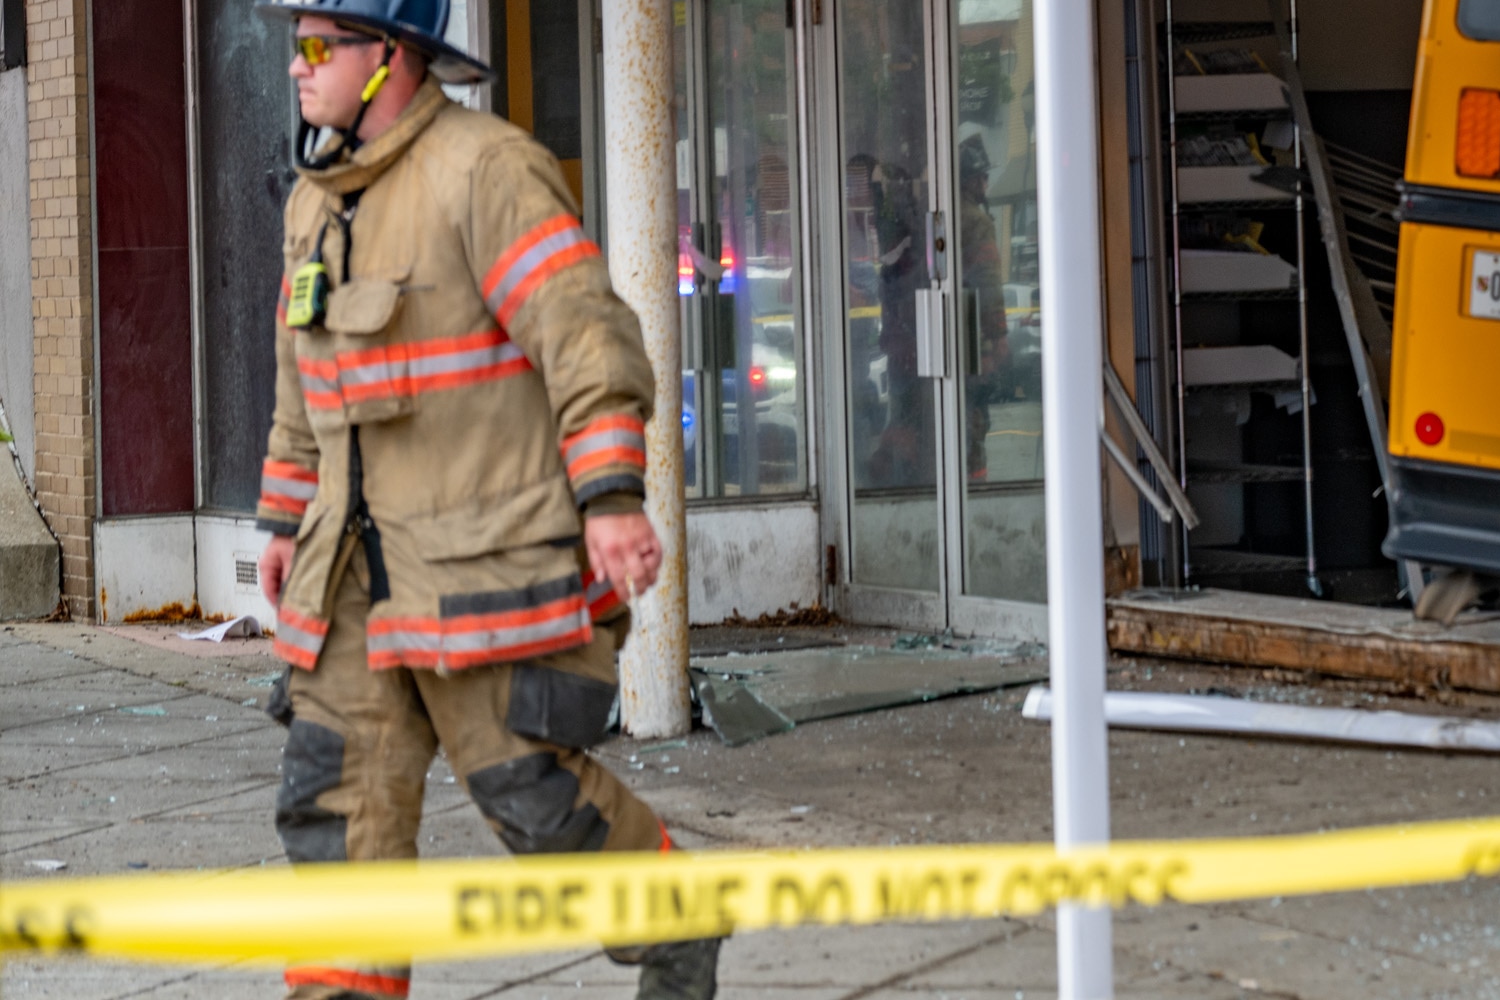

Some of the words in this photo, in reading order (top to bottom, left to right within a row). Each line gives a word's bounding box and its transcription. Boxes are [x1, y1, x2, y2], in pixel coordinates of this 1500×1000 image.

[457, 883, 586, 935] FIRE
[613, 878, 743, 930] LINE
[769, 867, 852, 926] DO
[875, 866, 985, 922] NOT
